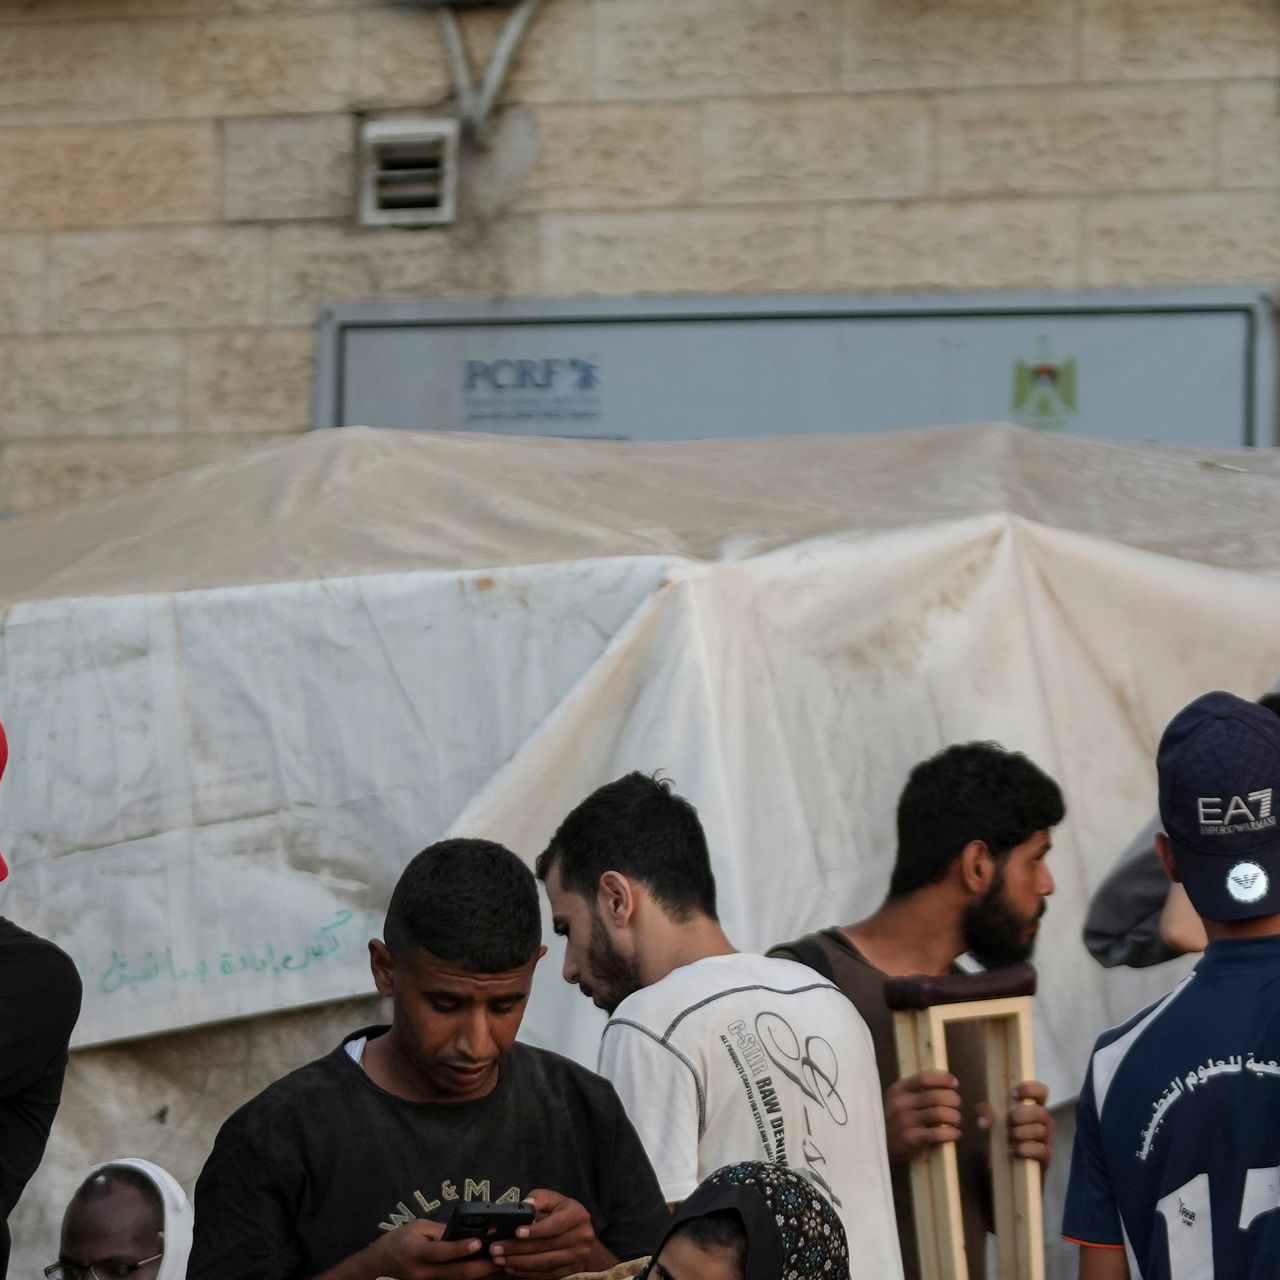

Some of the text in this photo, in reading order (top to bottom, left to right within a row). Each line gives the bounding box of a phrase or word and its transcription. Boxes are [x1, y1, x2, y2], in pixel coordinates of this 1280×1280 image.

[464, 358, 565, 391] PCRF
[1198, 788, 1273, 825] EA7
[726, 1042, 745, 1074] PRODUCTS
[1185, 1055, 1243, 1093] للعلوم
[756, 1075, 782, 1114] RAW
